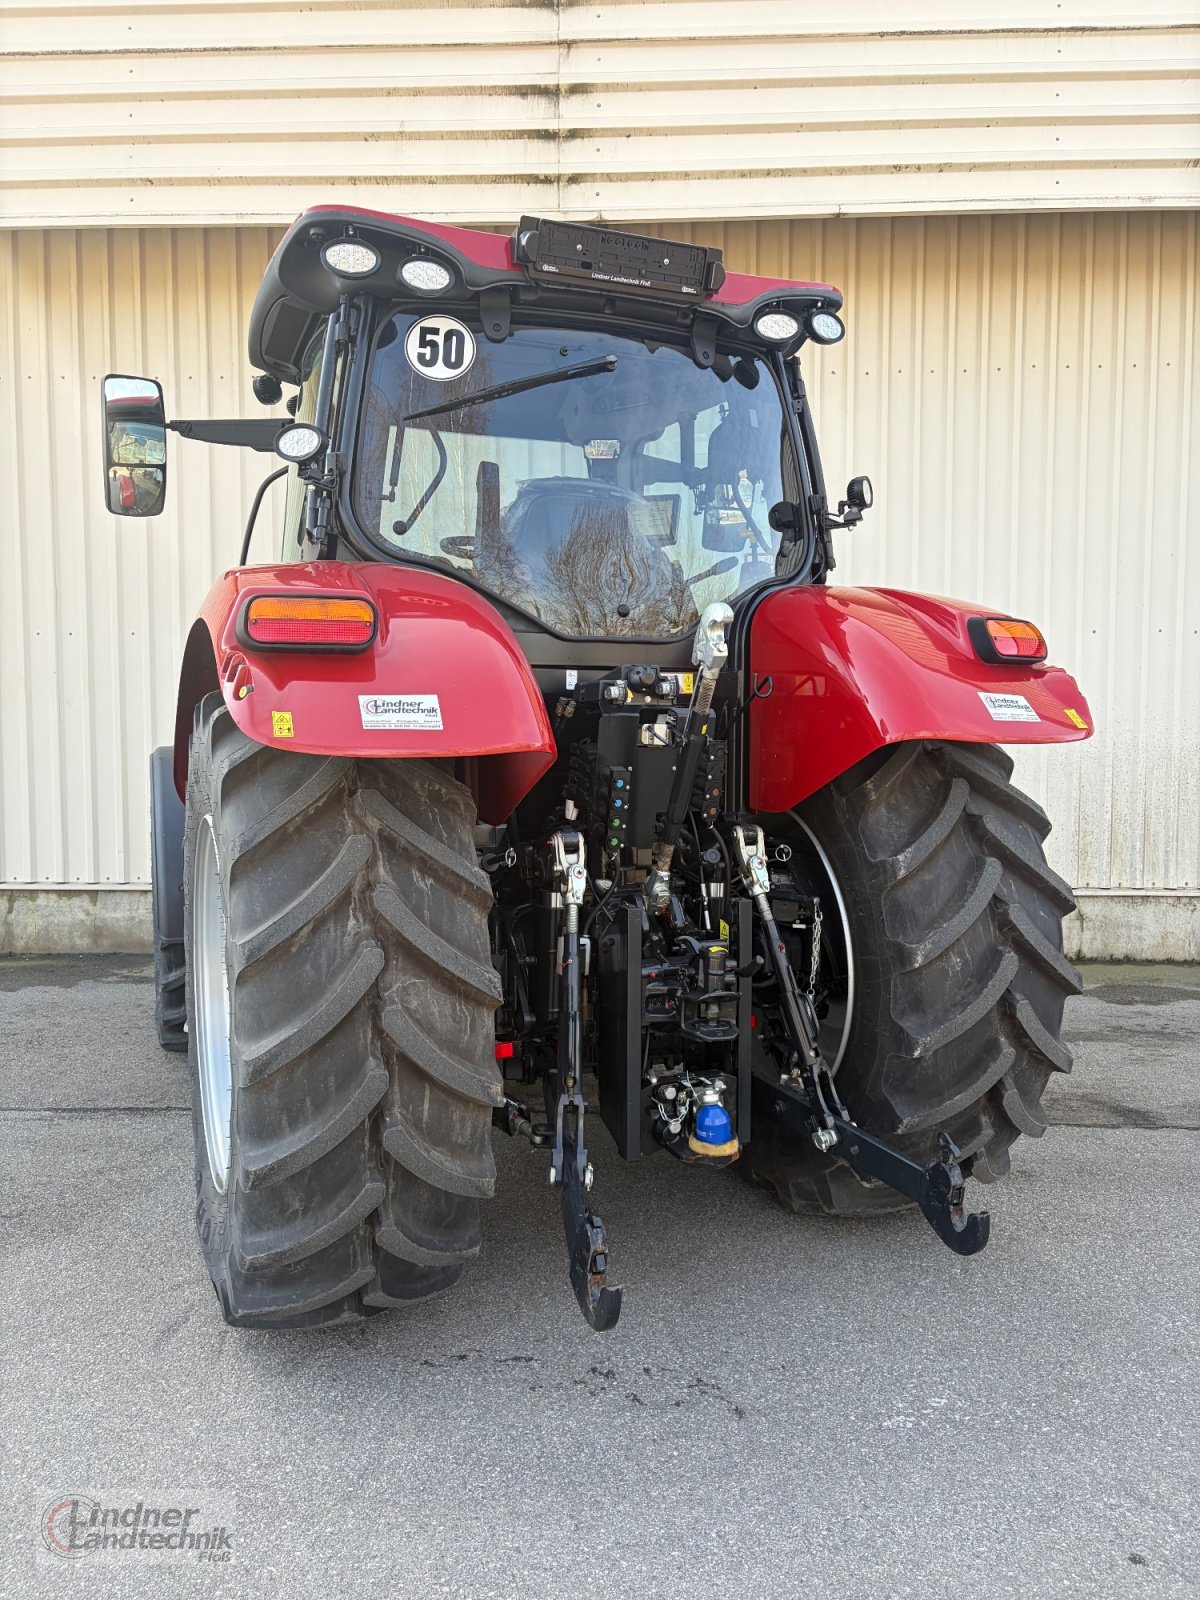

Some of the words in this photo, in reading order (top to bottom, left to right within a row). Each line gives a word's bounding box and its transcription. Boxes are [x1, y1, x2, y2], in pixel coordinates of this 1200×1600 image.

[592, 272, 610, 280] Lindner
[611, 275, 640, 285] Landtechnik
[417, 326, 465, 370] 50
[373, 699, 424, 708] Lindner
[375, 706, 438, 714] Landtechnik
